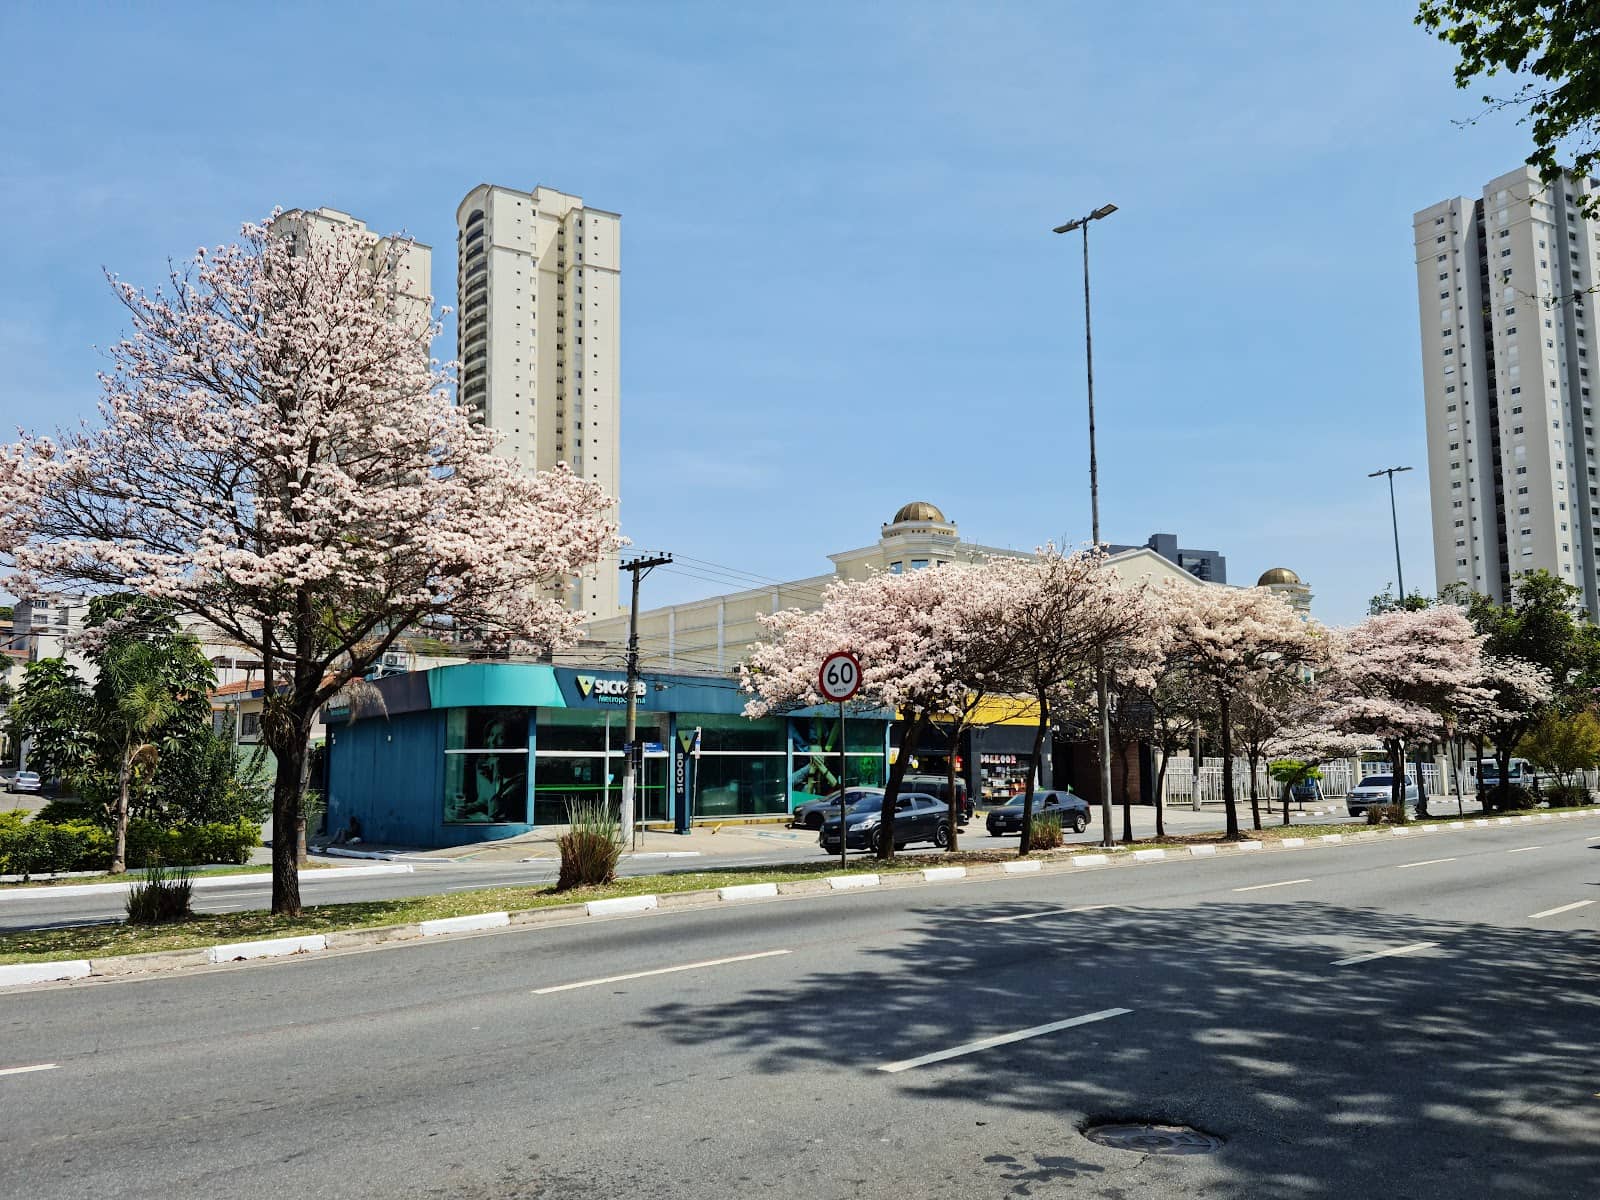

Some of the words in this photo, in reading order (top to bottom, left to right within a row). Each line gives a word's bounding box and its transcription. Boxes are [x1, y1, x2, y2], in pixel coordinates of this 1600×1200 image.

[828, 663, 853, 685] 60
[595, 679, 647, 695] SICOB
[676, 752, 684, 794] SICOOB
